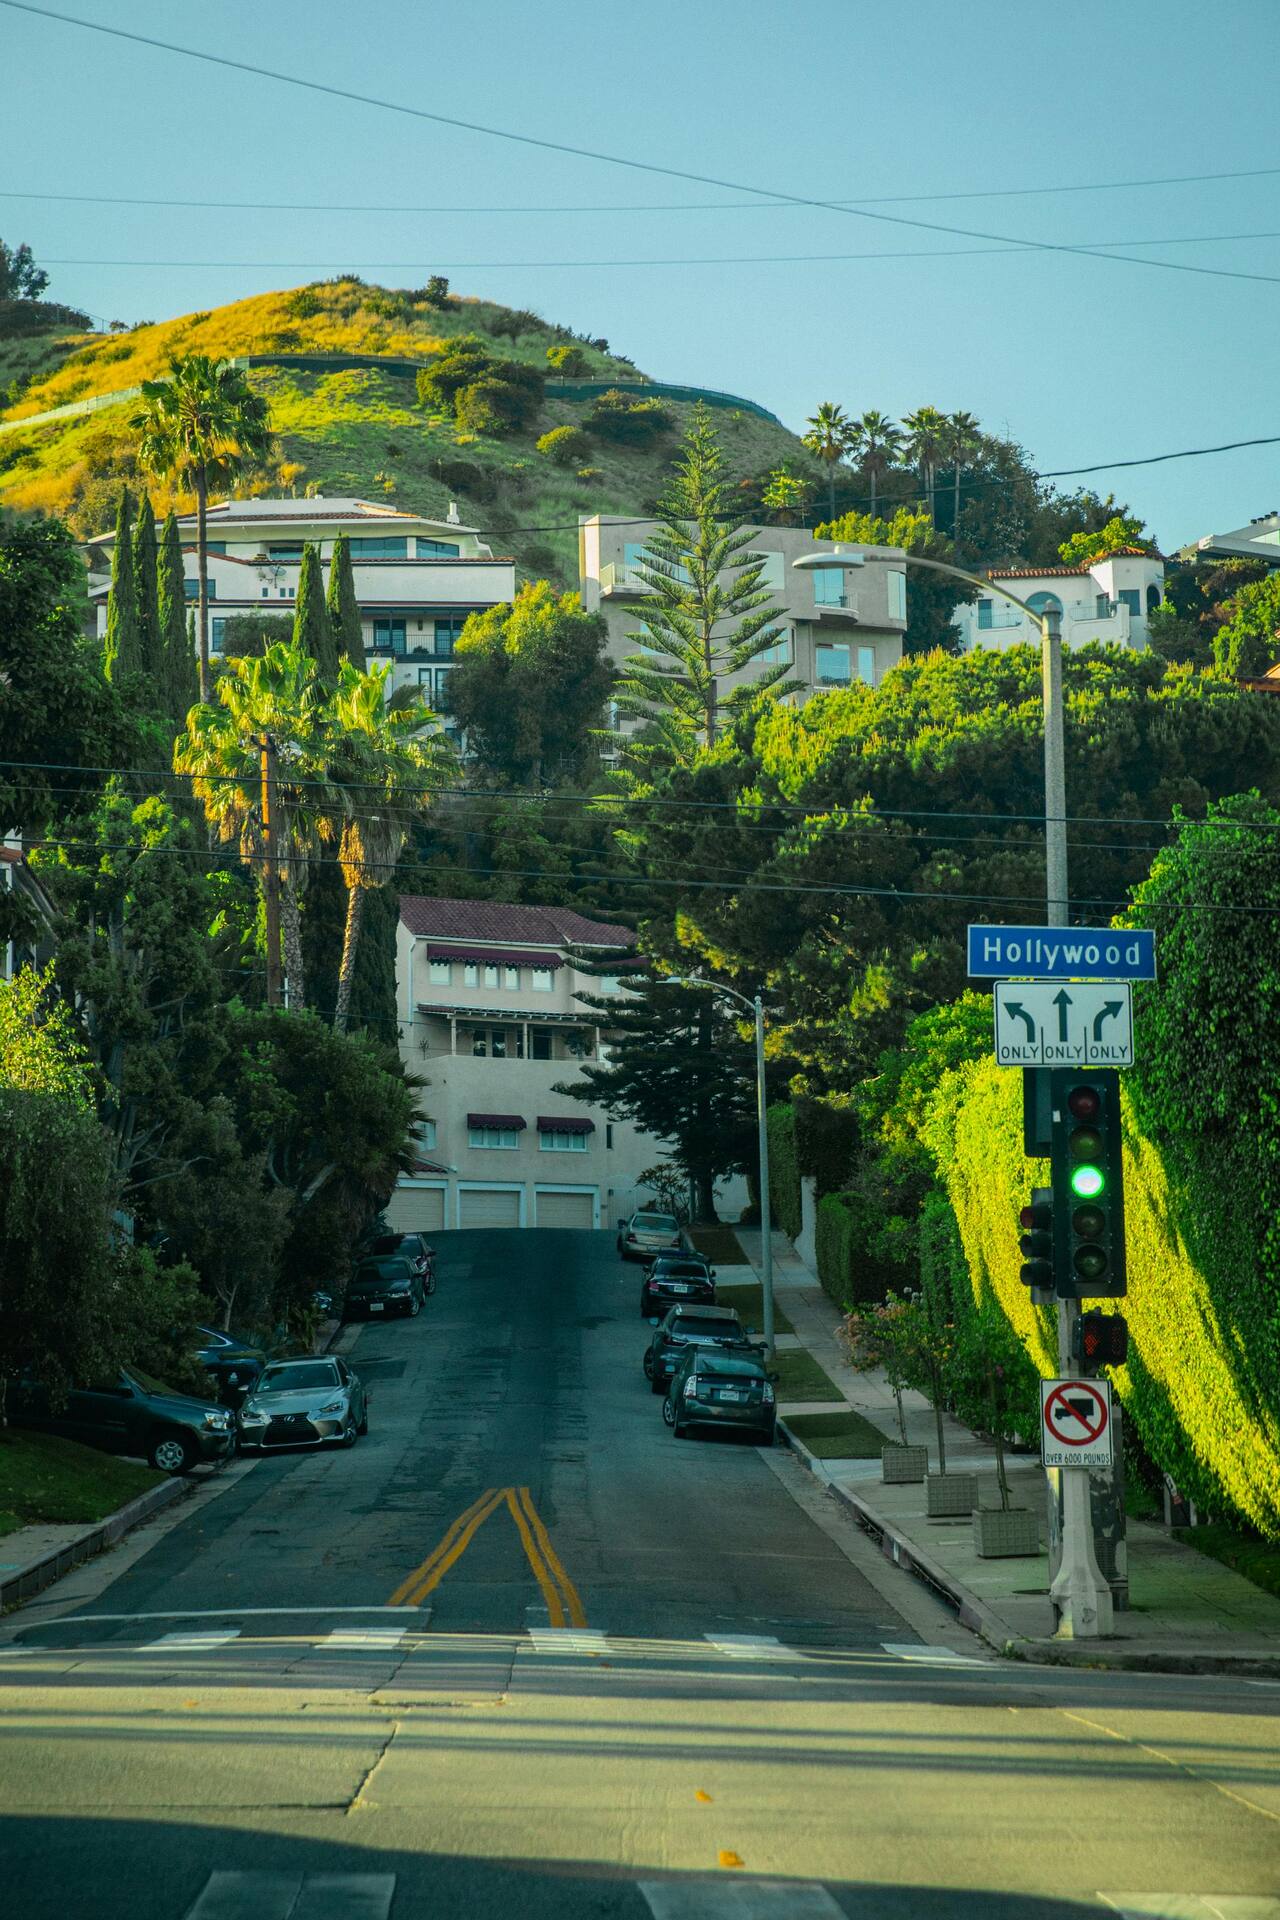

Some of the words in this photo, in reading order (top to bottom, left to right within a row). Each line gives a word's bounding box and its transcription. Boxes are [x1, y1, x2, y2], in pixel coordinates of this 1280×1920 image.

[984, 937, 1140, 970] Hollywood
[1001, 1046, 1039, 1059] ONLY
[1045, 1046, 1082, 1059] ONLY
[1090, 1046, 1128, 1059] ONLY
[1046, 1453, 1062, 1463] OVER
[1065, 1453, 1081, 1463] 6000
[1084, 1453, 1109, 1464] POUNDS
